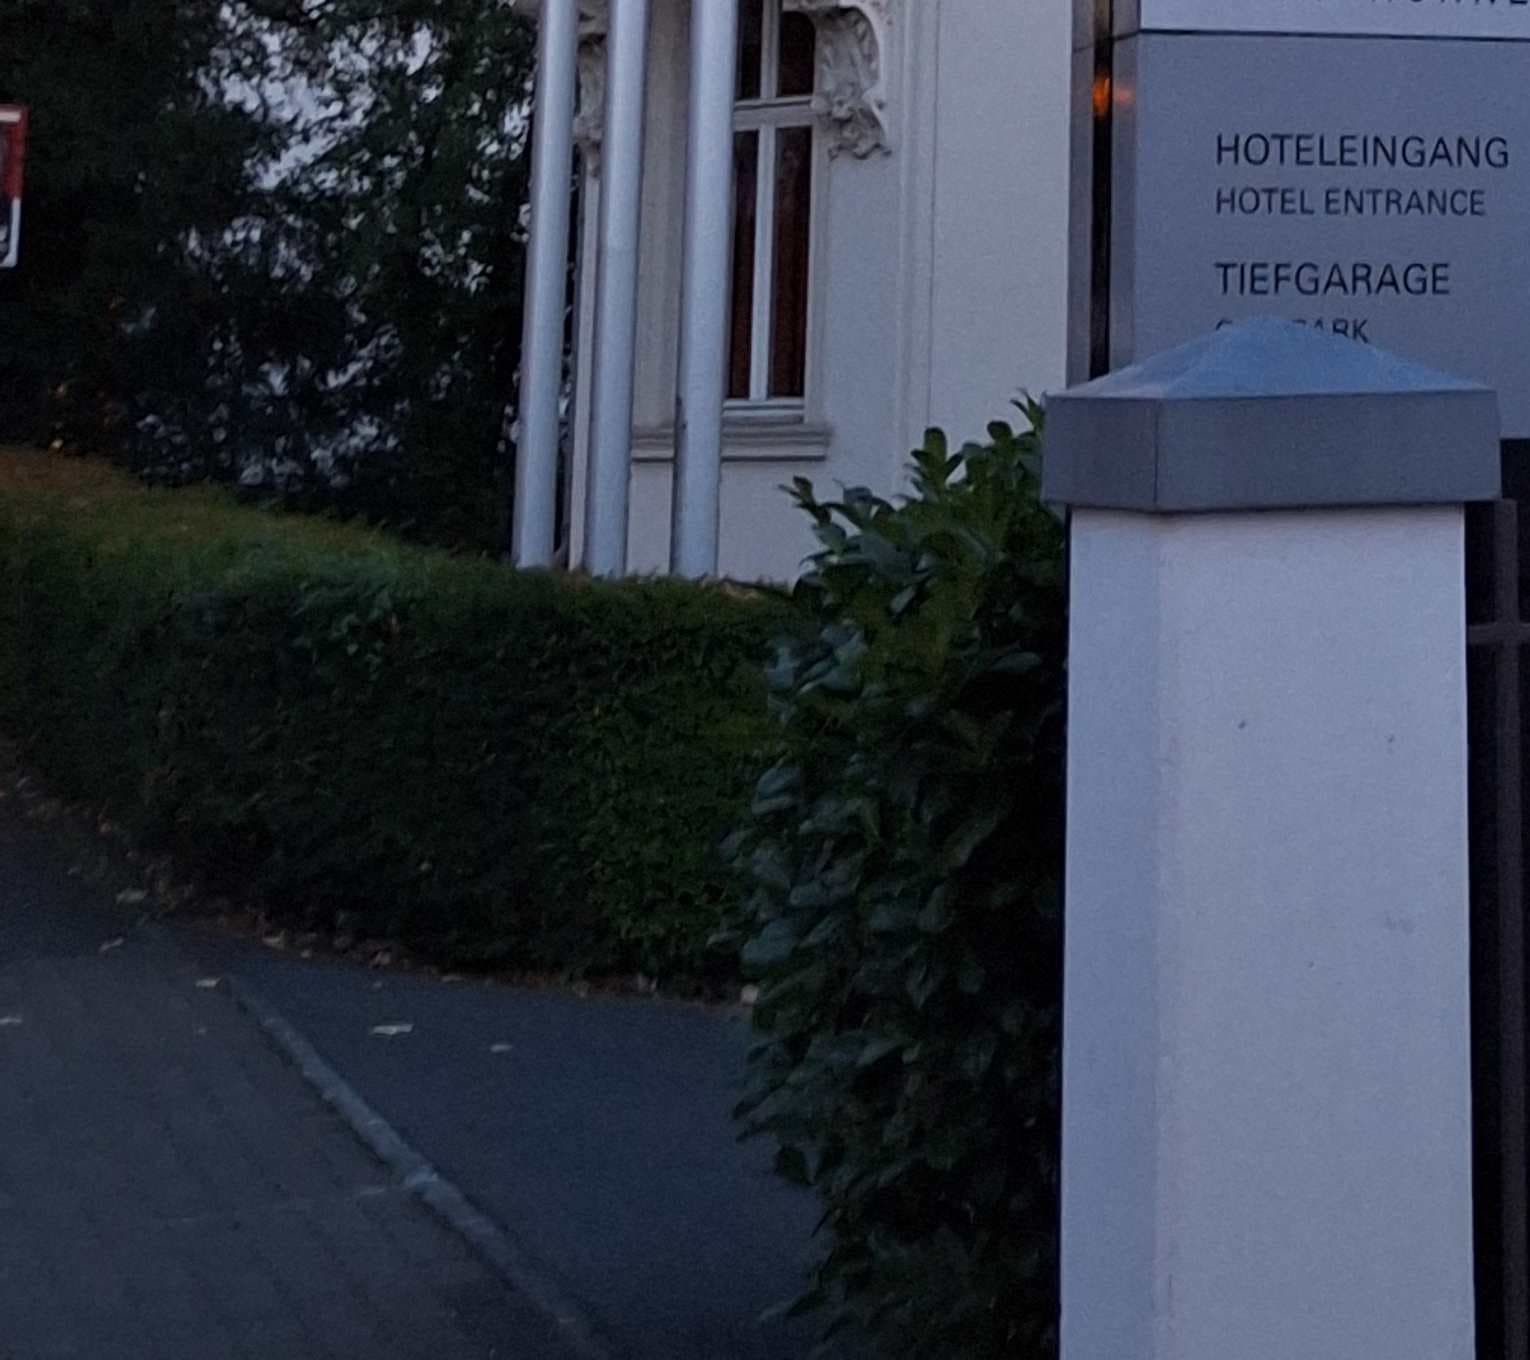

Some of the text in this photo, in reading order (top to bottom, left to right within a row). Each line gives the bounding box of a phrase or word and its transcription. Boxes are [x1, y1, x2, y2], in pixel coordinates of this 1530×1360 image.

[1215, 133, 1510, 169] HOTELEINGANG
[1215, 187, 1486, 217] HOTEL ENTRANCE
[1214, 262, 1450, 296] TIEFGARAGE
